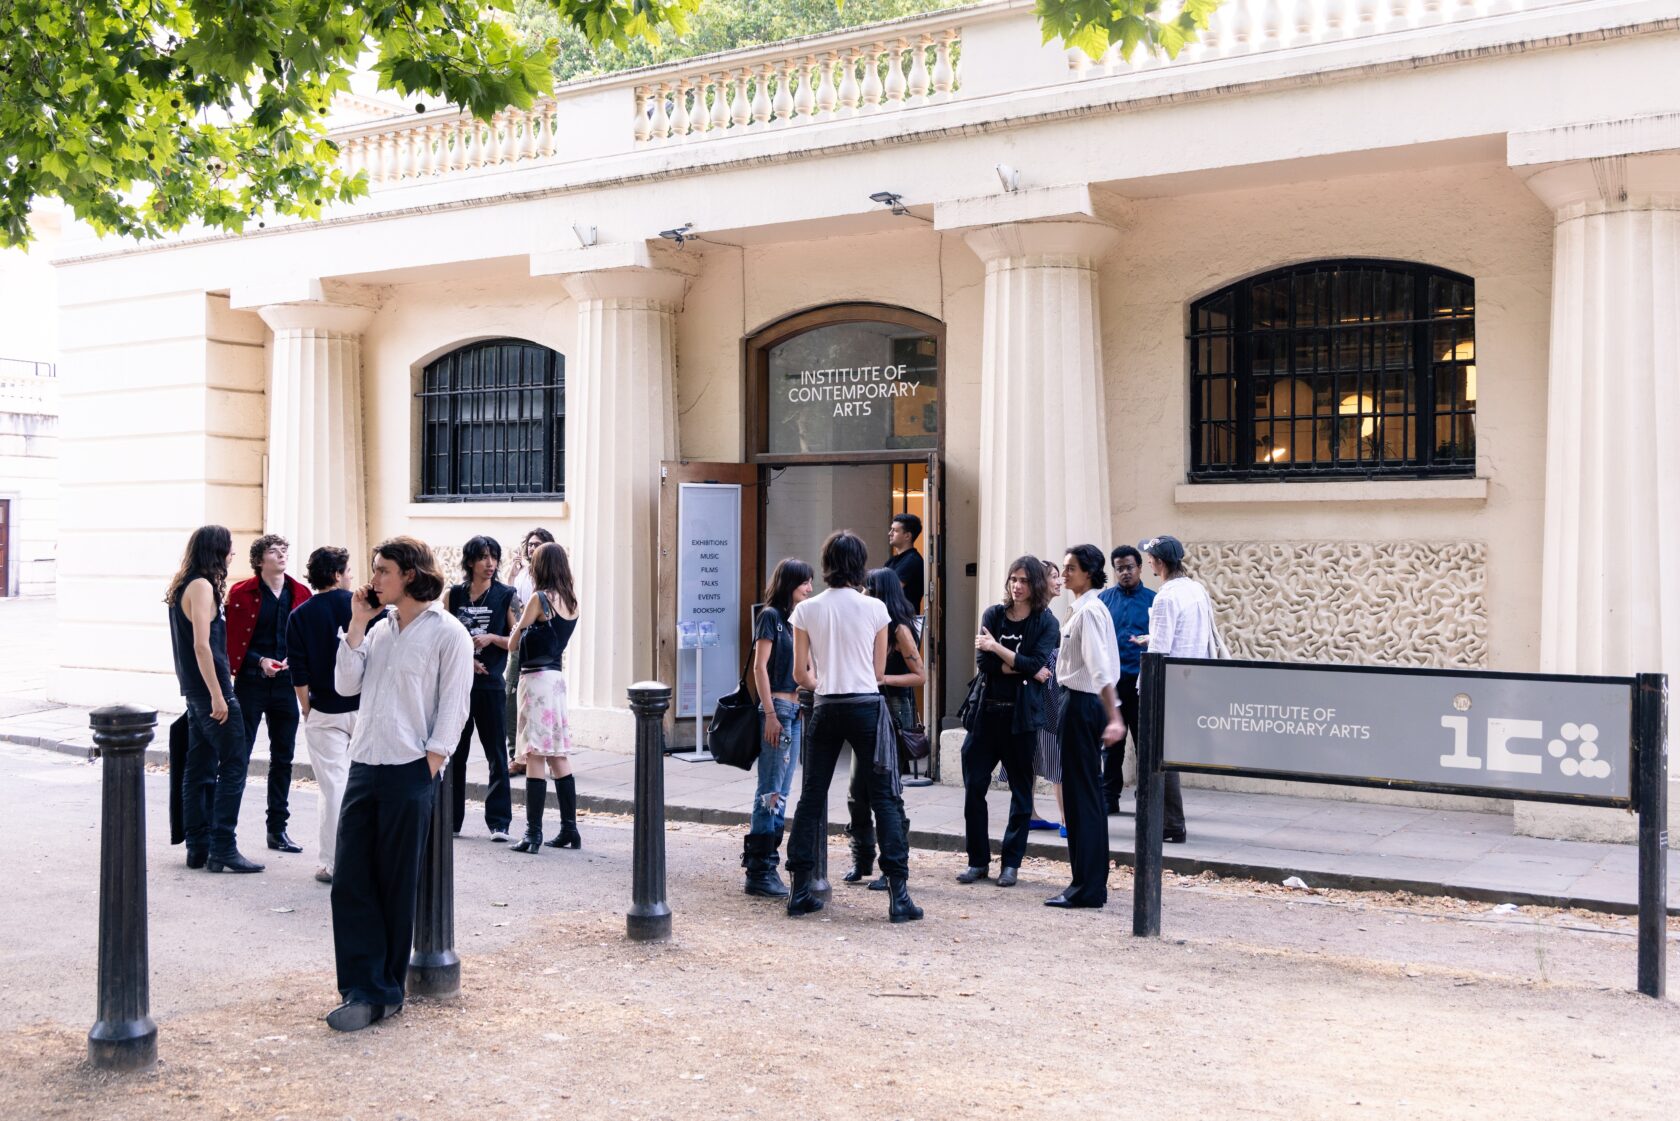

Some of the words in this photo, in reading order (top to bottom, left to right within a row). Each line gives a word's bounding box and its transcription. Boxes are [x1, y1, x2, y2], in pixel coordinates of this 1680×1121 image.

[801, 366, 880, 385] INSTITUTE
[884, 365, 907, 380] OF
[788, 381, 920, 402] CONTEMPORARY
[833, 401, 872, 417] ARTS
[1229, 703, 1310, 720] INSTITUTE
[1313, 707, 1337, 722] OF
[1196, 715, 1327, 736] CONTEMPORARY
[1329, 724, 1371, 739] ARTS
